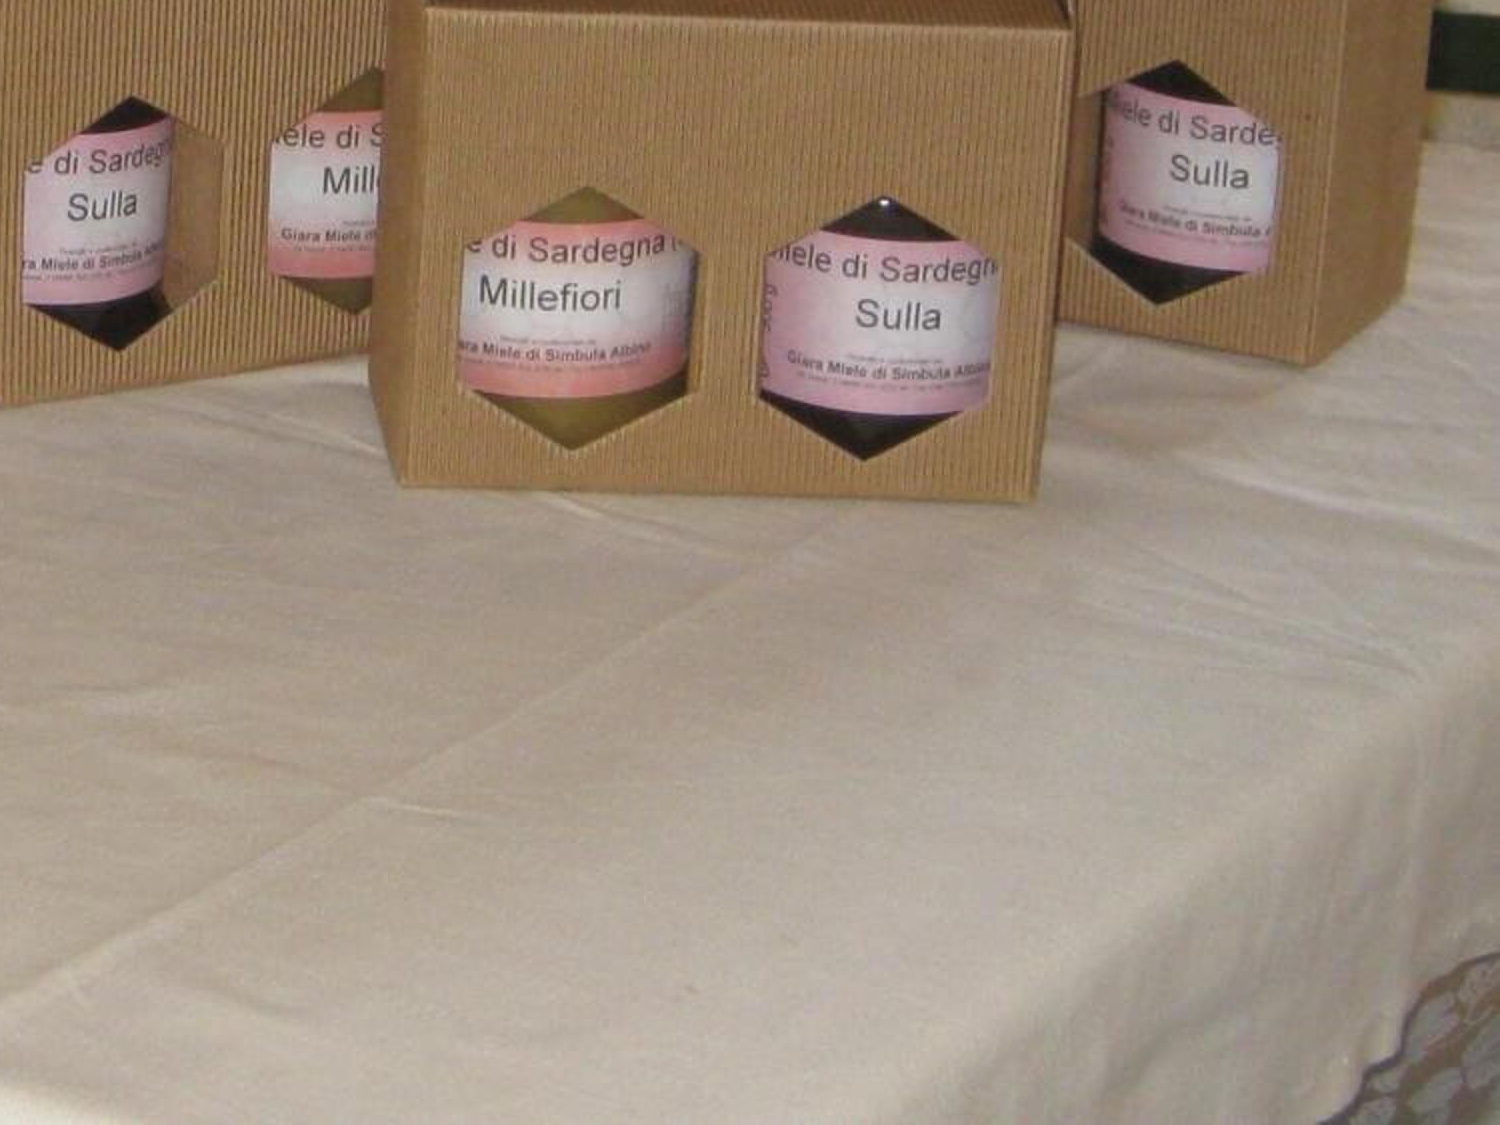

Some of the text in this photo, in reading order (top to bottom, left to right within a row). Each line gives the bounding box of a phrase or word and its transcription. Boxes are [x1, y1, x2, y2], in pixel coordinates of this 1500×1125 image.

[275, 125, 325, 149] ele
[336, 125, 359, 149] di
[1158, 110, 1180, 135] di
[53, 150, 79, 175] di
[1170, 153, 1249, 190] Sulla
[322, 165, 379, 194] Mill
[67, 190, 138, 222] Sulla
[491, 235, 516, 260] di
[528, 234, 666, 267] Sardegna
[842, 254, 867, 280] di
[880, 256, 998, 286] Sardegn
[479, 274, 622, 312] Millefiori
[855, 298, 942, 331] Sulla
[526, 347, 540, 361] di
